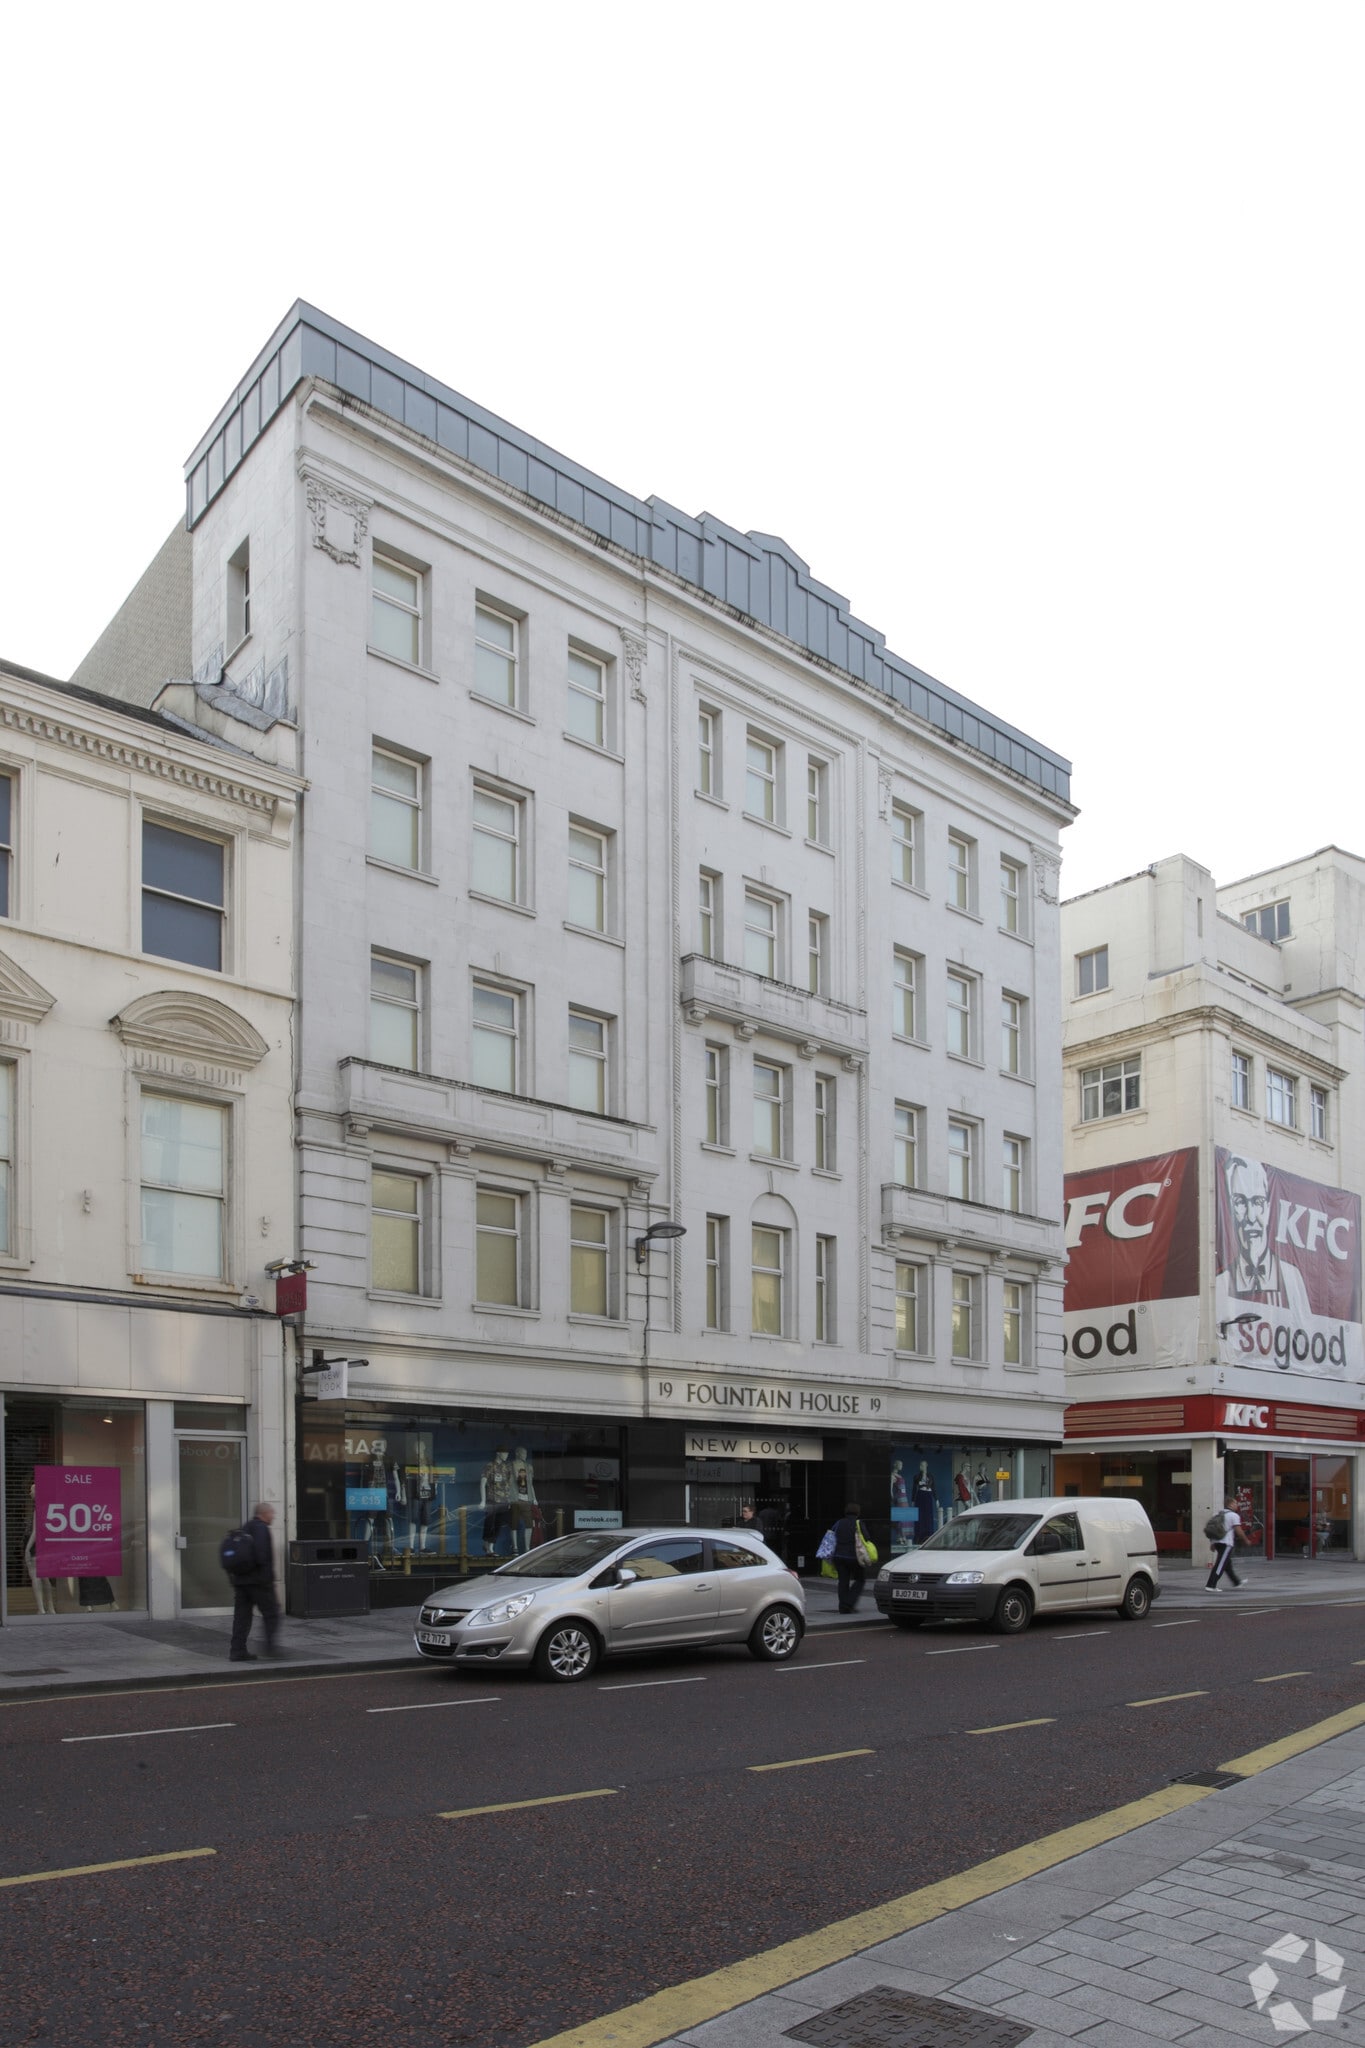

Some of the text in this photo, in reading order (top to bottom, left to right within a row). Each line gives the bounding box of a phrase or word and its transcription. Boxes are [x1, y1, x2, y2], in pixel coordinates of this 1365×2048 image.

[1064, 1183, 1162, 1249] FC
[1275, 1199, 1350, 1260] KFC
[1063, 1309, 1138, 1359] od
[1237, 1320, 1347, 1369] sogood
[320, 1382, 341, 1392] LOOK
[321, 1370, 340, 1380] NEW
[659, 1382, 881, 1414] 19 FOUNTAIN HOUSE 19
[1222, 1403, 1270, 1429] KFC
[691, 1438, 800, 1455] NEW LOOK
[64, 1473, 93, 1484] SALE
[45, 1503, 113, 1533] 50%
[92, 1523, 113, 1532] OFF
[431, 1634, 446, 1644] 7172
